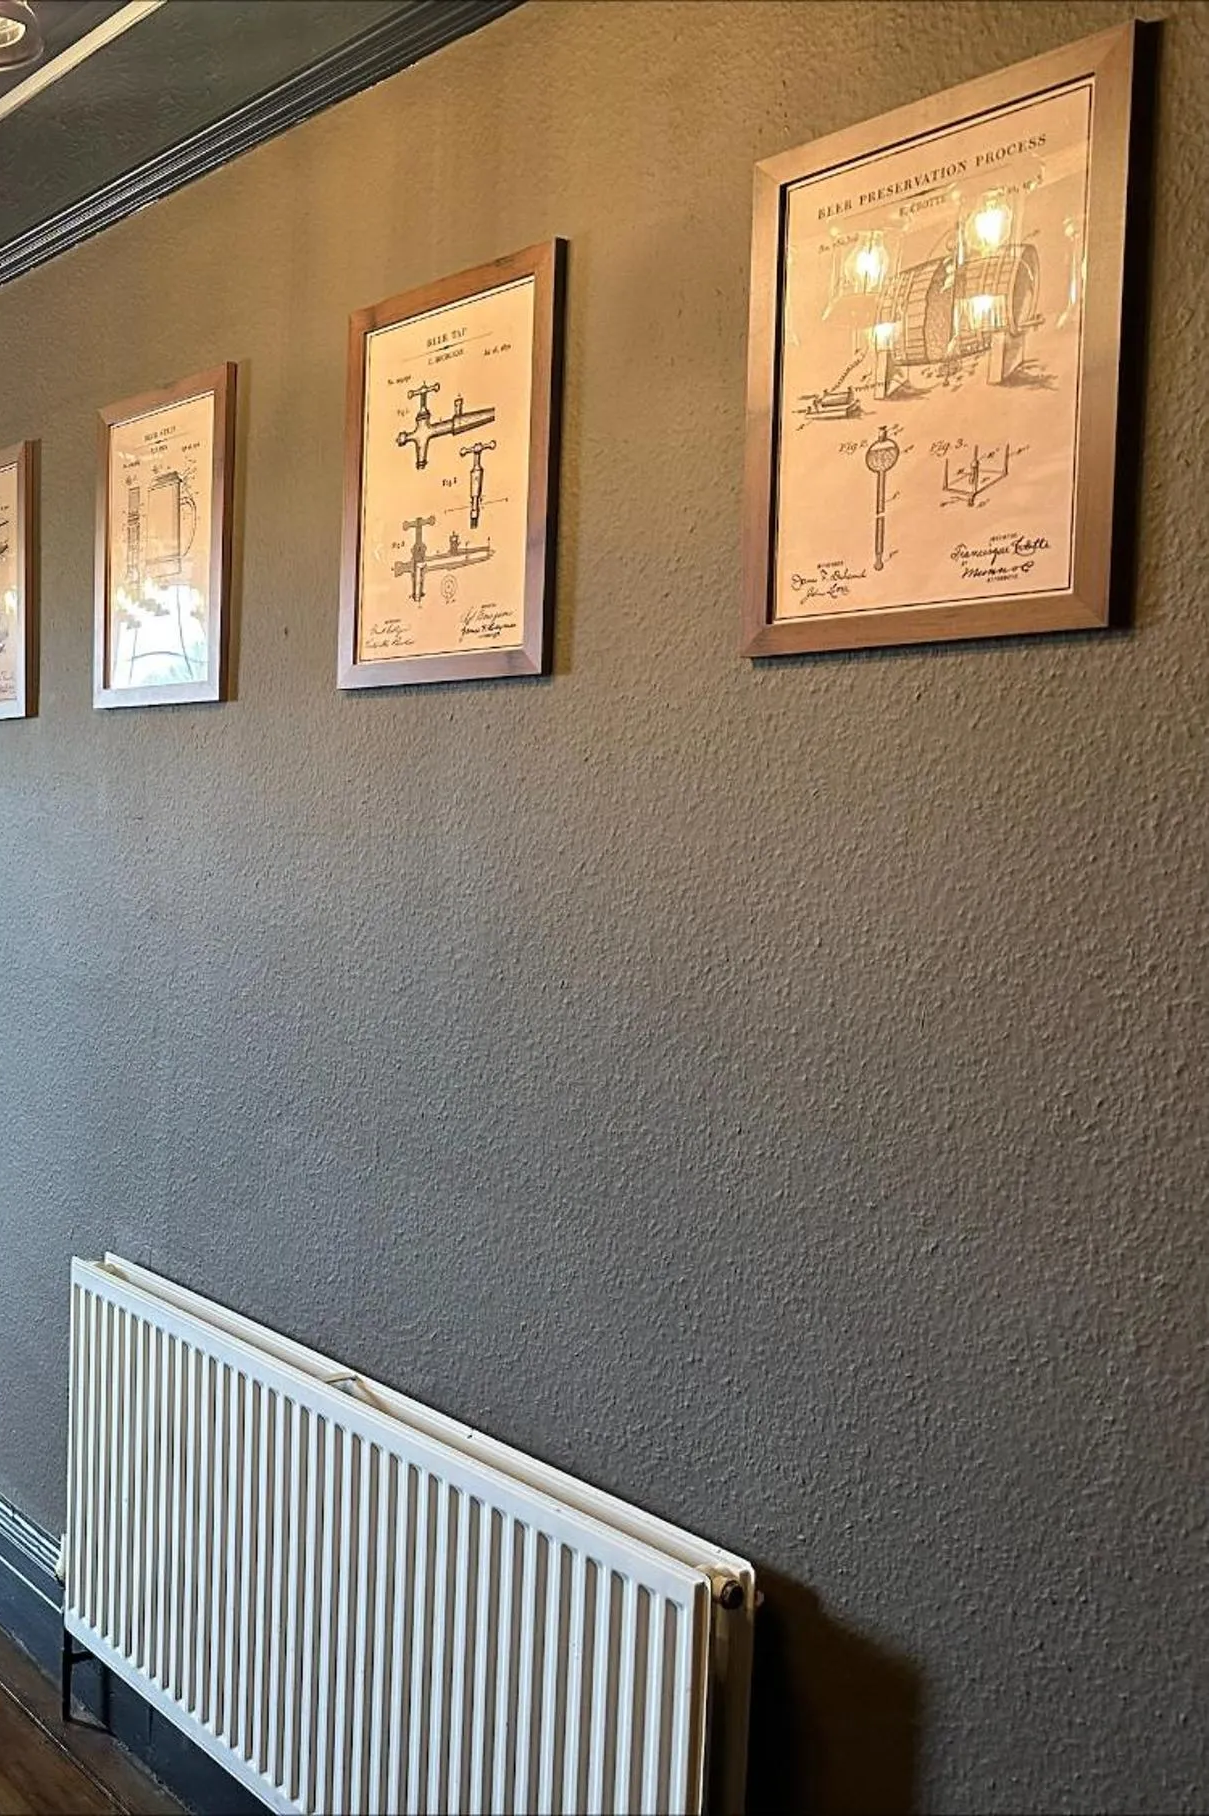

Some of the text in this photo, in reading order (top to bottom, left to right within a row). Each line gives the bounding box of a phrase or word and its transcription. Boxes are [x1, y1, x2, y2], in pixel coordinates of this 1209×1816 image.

[817, 199, 853, 220] BEER
[859, 160, 968, 206] PRESERVATION
[974, 133, 1047, 167] PROCESS
